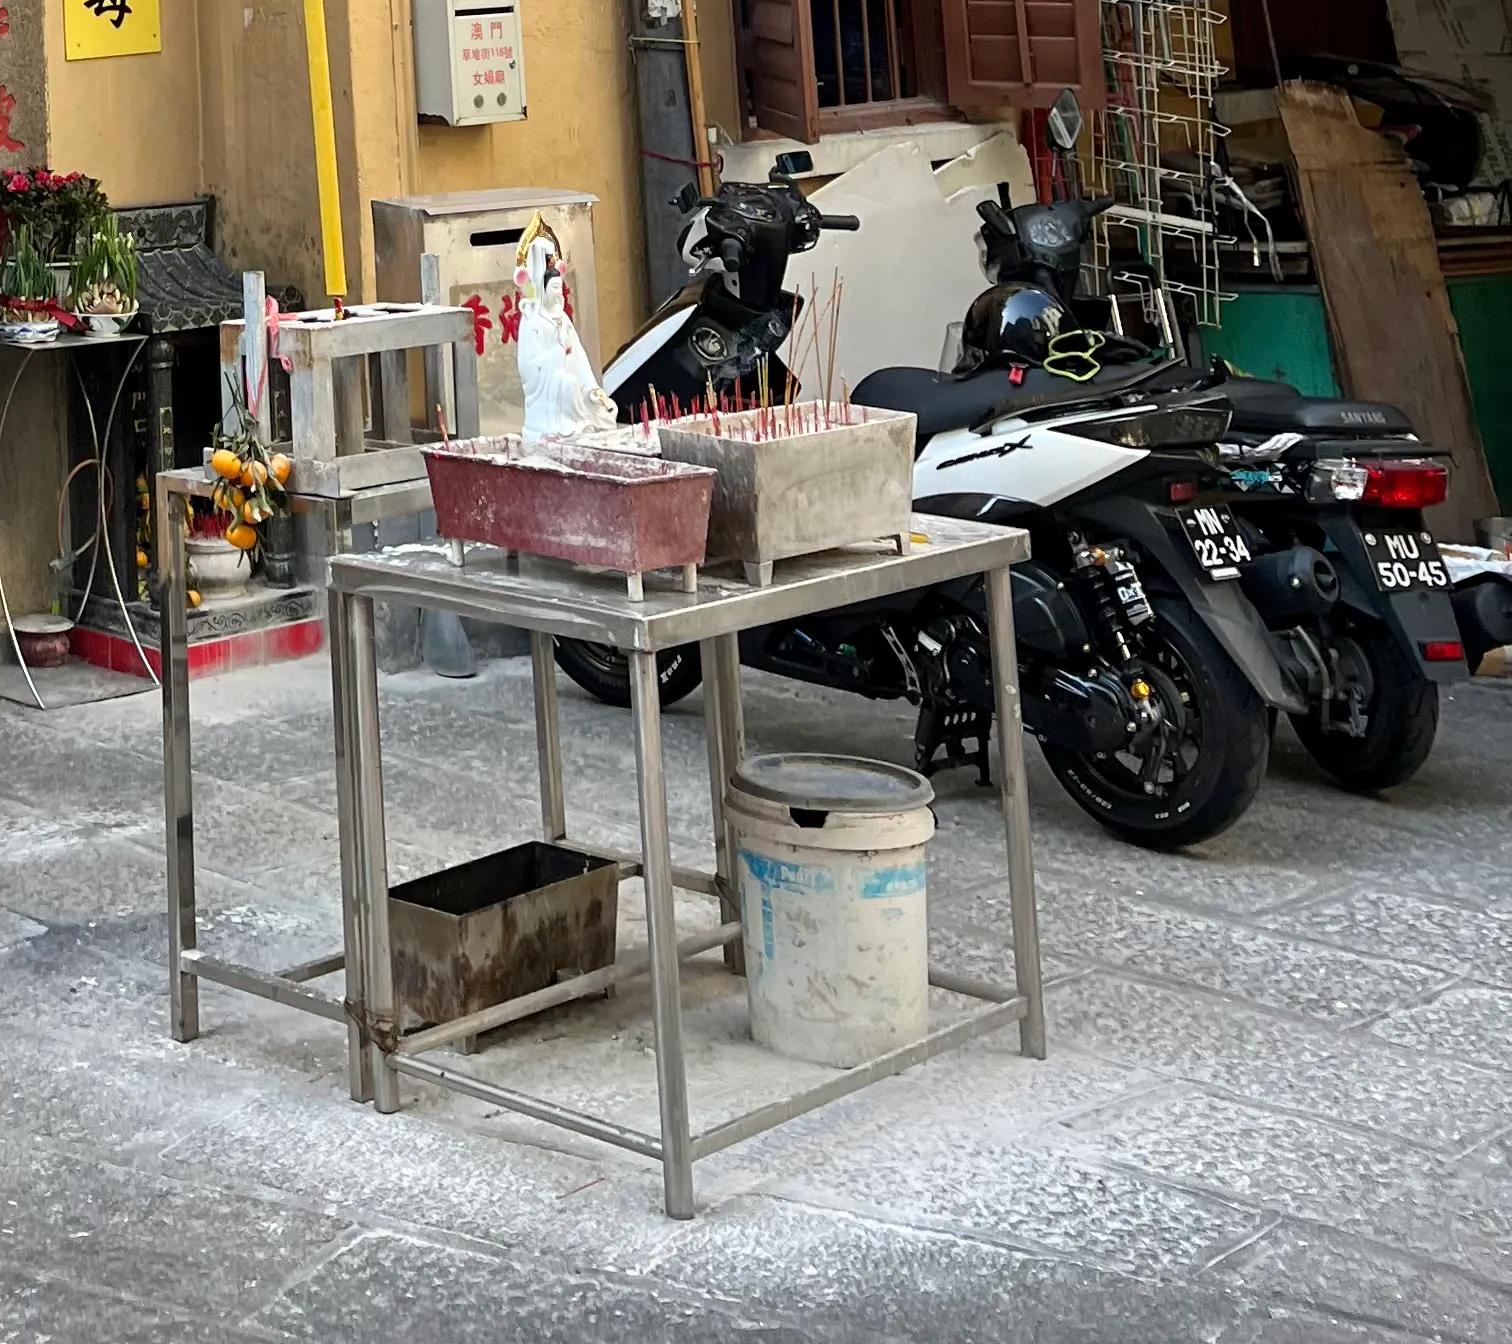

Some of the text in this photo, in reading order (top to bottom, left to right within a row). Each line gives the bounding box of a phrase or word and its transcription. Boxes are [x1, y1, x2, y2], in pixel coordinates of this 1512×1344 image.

[471, 21, 503, 40] 澳門
[1194, 508, 1226, 536] MN
[1194, 534, 1252, 568] 22-34
[1384, 534, 1420, 560] MU
[1377, 561, 1448, 589] 50-45
